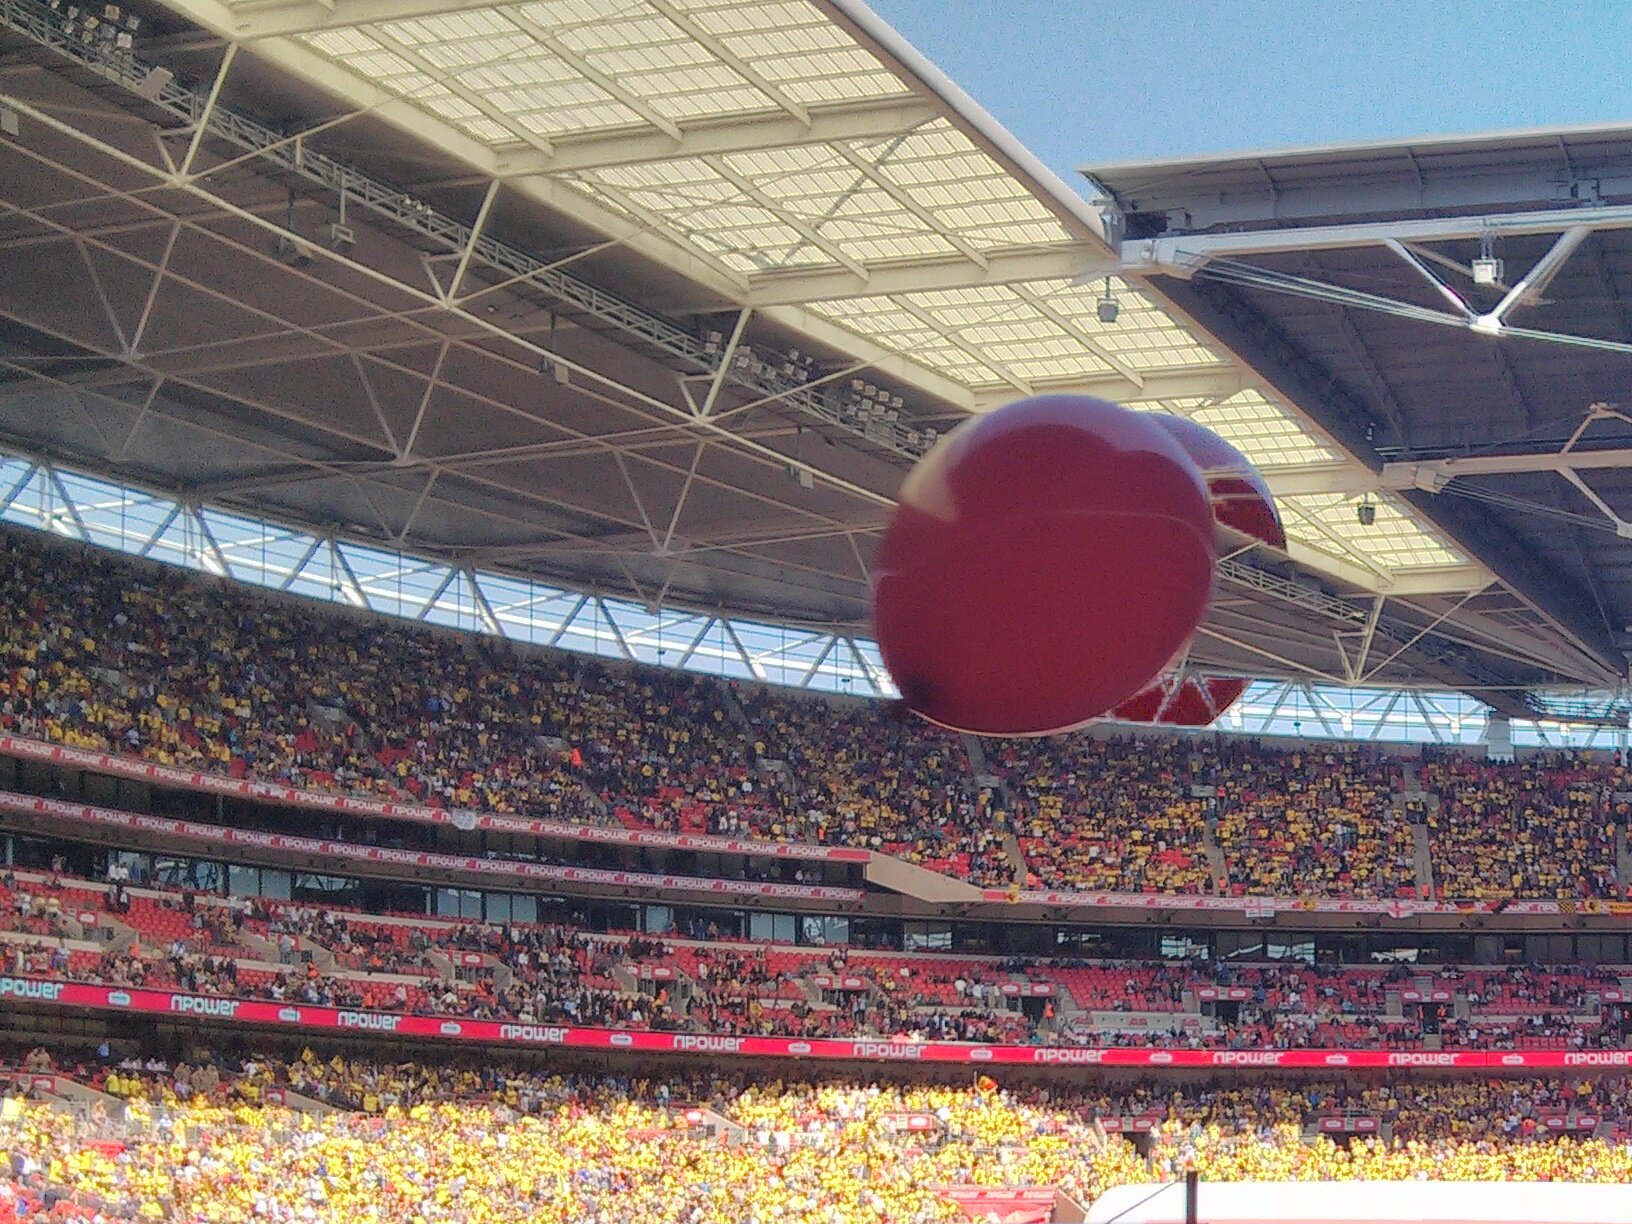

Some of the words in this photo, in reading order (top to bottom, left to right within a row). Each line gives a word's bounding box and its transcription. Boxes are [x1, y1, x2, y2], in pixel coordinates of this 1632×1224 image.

[0, 794, 35, 806] power
[295, 791, 337, 805] npower
[43, 800, 84, 814] npower
[343, 799, 386, 812] npower
[391, 804, 435, 818] npower
[91, 809, 130, 823] npower
[137, 817, 177, 831] npower
[490, 817, 534, 829] npower
[540, 823, 582, 835] npower
[184, 825, 224, 839] npower
[232, 829, 273, 844] npower
[588, 829, 632, 841] npower
[280, 837, 322, 851] npower
[638, 833, 681, 845] npower
[687, 838, 730, 849] npower
[328, 844, 372, 857] npower
[736, 842, 781, 853] npower
[785, 846, 831, 857] npower
[377, 849, 419, 862] npower
[426, 854, 467, 867] npower
[475, 861, 518, 873] npower
[525, 866, 566, 878] npower
[573, 870, 615, 883] npower
[624, 874, 666, 886] npower
[673, 879, 716, 890] npower
[721, 882, 766, 894] npower
[771, 886, 815, 897] npower
[820, 889, 864, 900] npower
[0, 977, 63, 1000] power
[170, 994, 240, 1017] npower
[337, 1011, 401, 1030] npower
[500, 1024, 569, 1042] npower
[673, 1034, 745, 1052] npower
[853, 1043, 926, 1058] npower
[1034, 1048, 1106, 1062] npower
[1213, 1051, 1286, 1066] npower
[1388, 1052, 1459, 1066] npower
